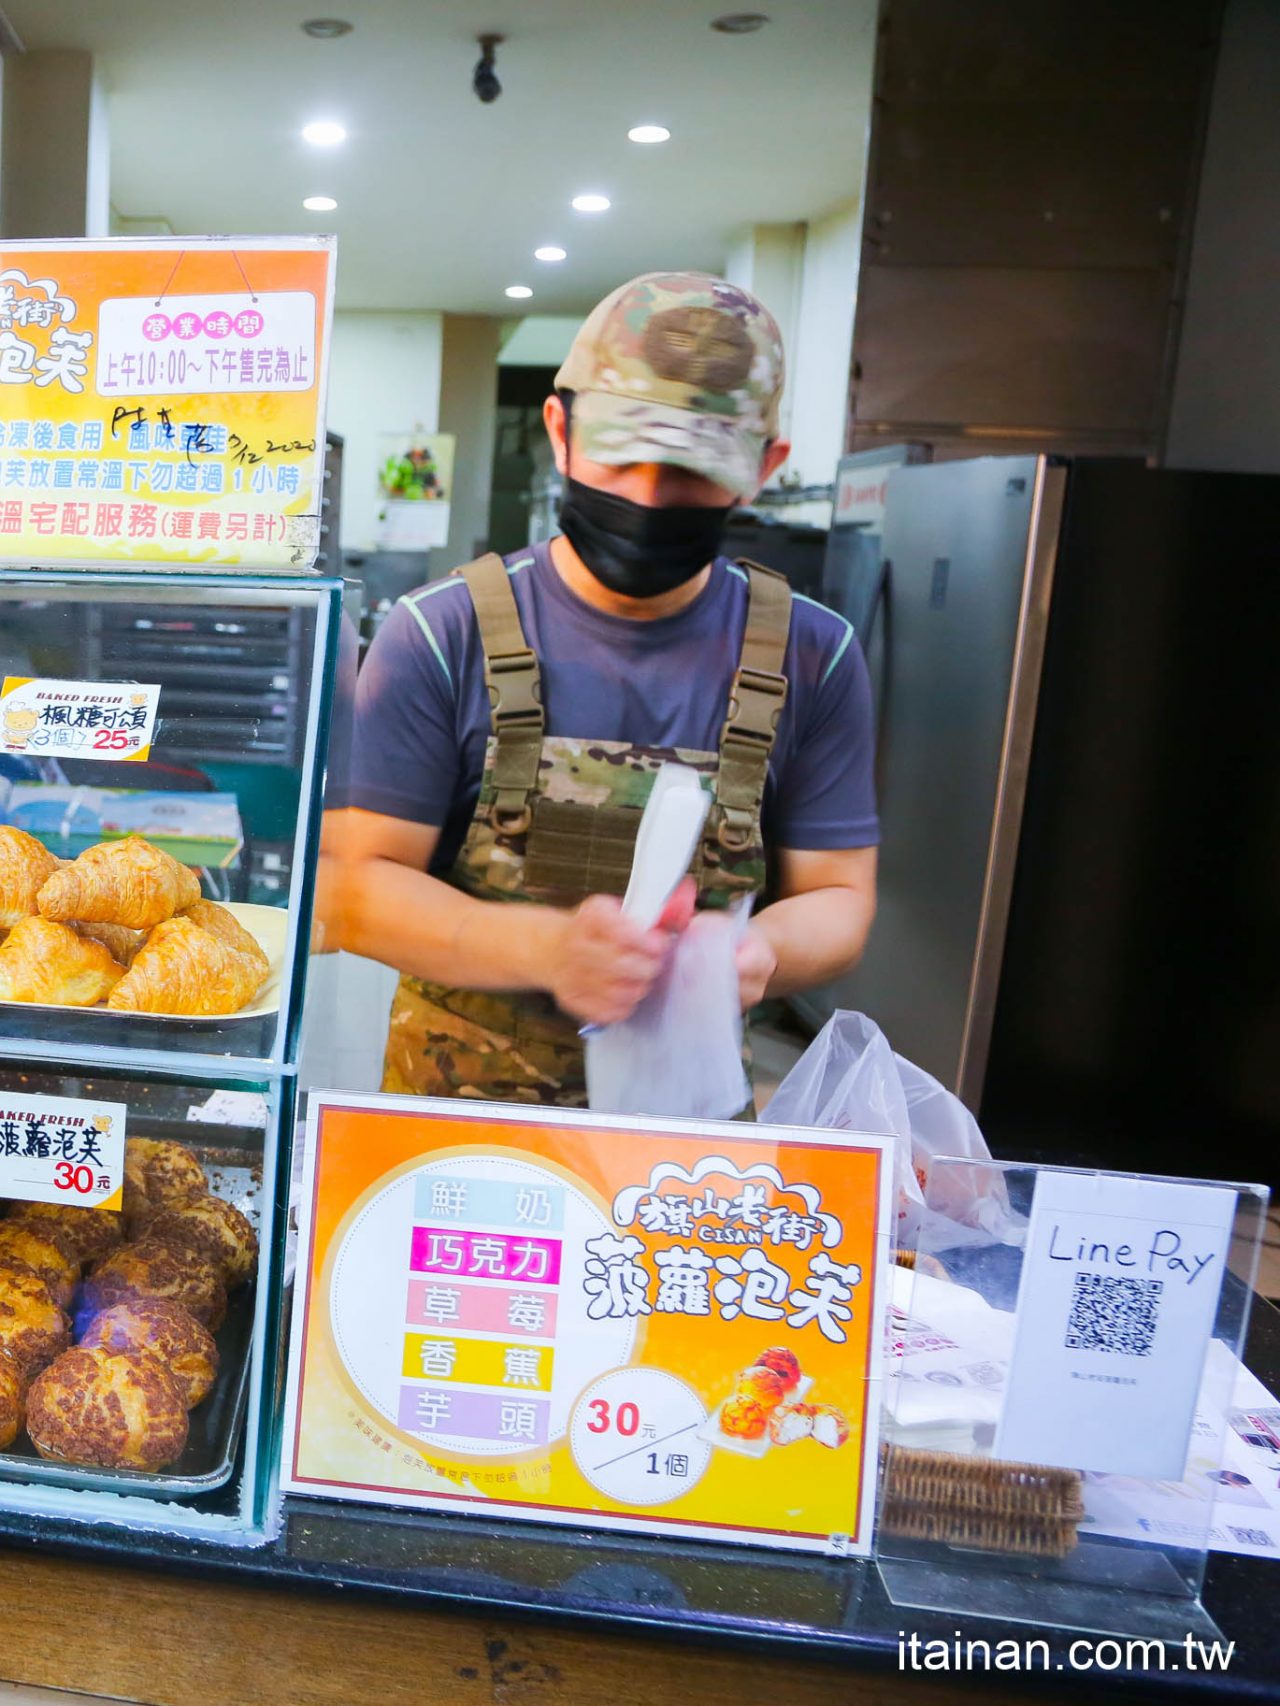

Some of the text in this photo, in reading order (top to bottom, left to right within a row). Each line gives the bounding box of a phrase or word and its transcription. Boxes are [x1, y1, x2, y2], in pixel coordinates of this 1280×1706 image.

[145, 314, 261, 340] 營業時間
[36, 692, 123, 704] BAKED FRESH
[39, 704, 148, 731] 楓糖可頌
[39, 1115, 85, 1127] FRESH
[638, 1184, 820, 1250] 旗山老街
[698, 1224, 763, 1245] CISAN
[425, 1233, 549, 1279] 巧克力
[1049, 1225, 1215, 1285] Line Pay
[583, 1232, 862, 1344] 菠蘿泡芙
[646, 1451, 689, 1478] 1個
